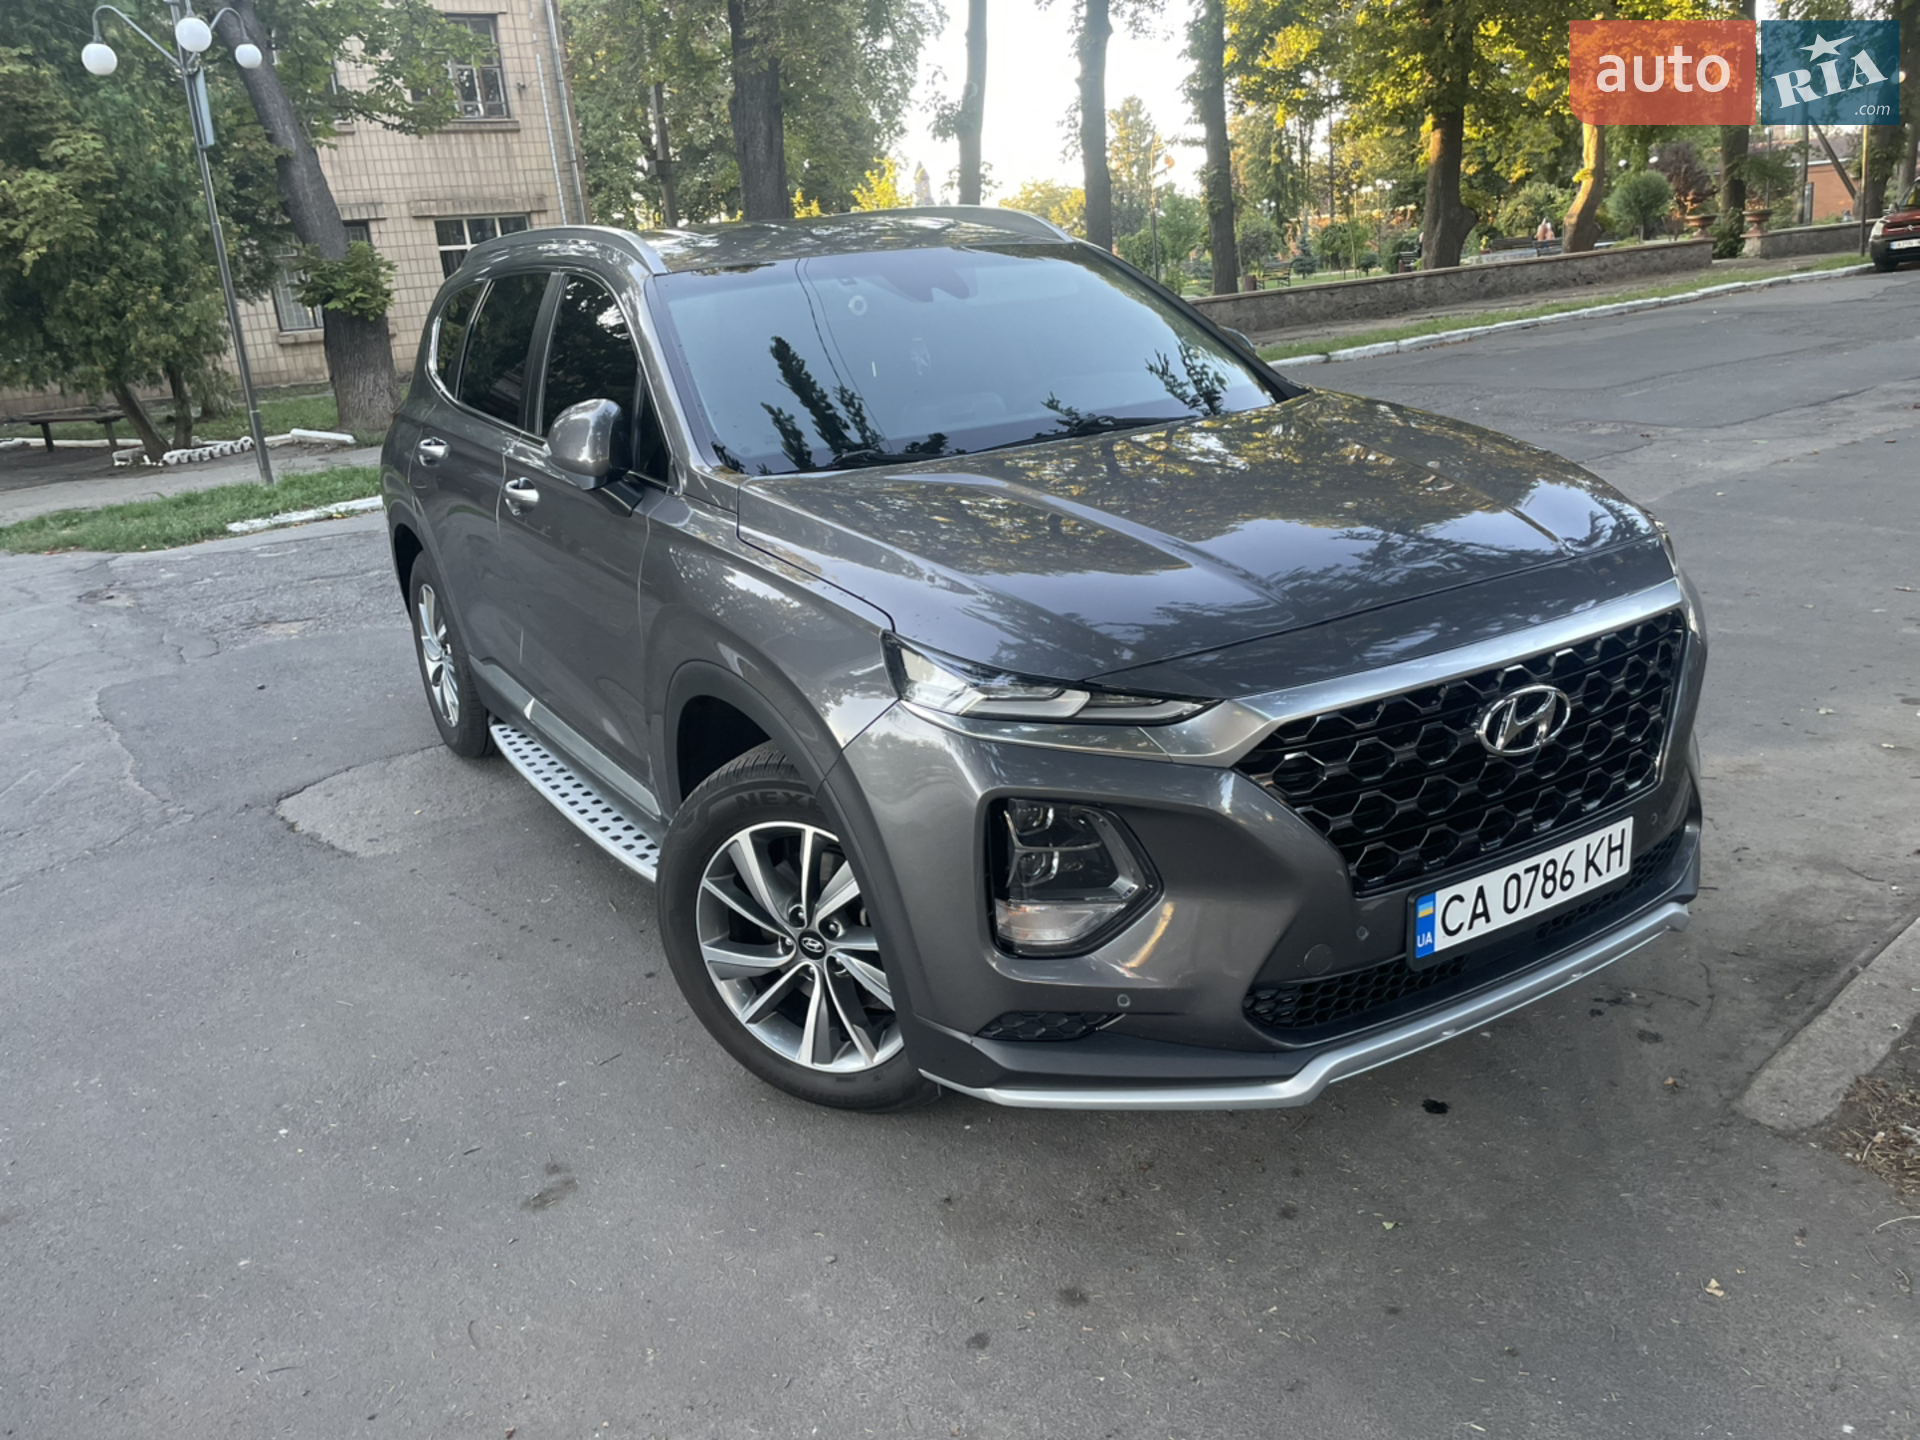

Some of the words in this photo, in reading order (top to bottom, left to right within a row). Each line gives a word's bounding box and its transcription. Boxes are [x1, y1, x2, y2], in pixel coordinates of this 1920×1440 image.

[1441, 885, 1491, 937] CA
[1503, 849, 1575, 914] 0786
[1584, 828, 1626, 884] KH
[1417, 932, 1433, 948] UA
